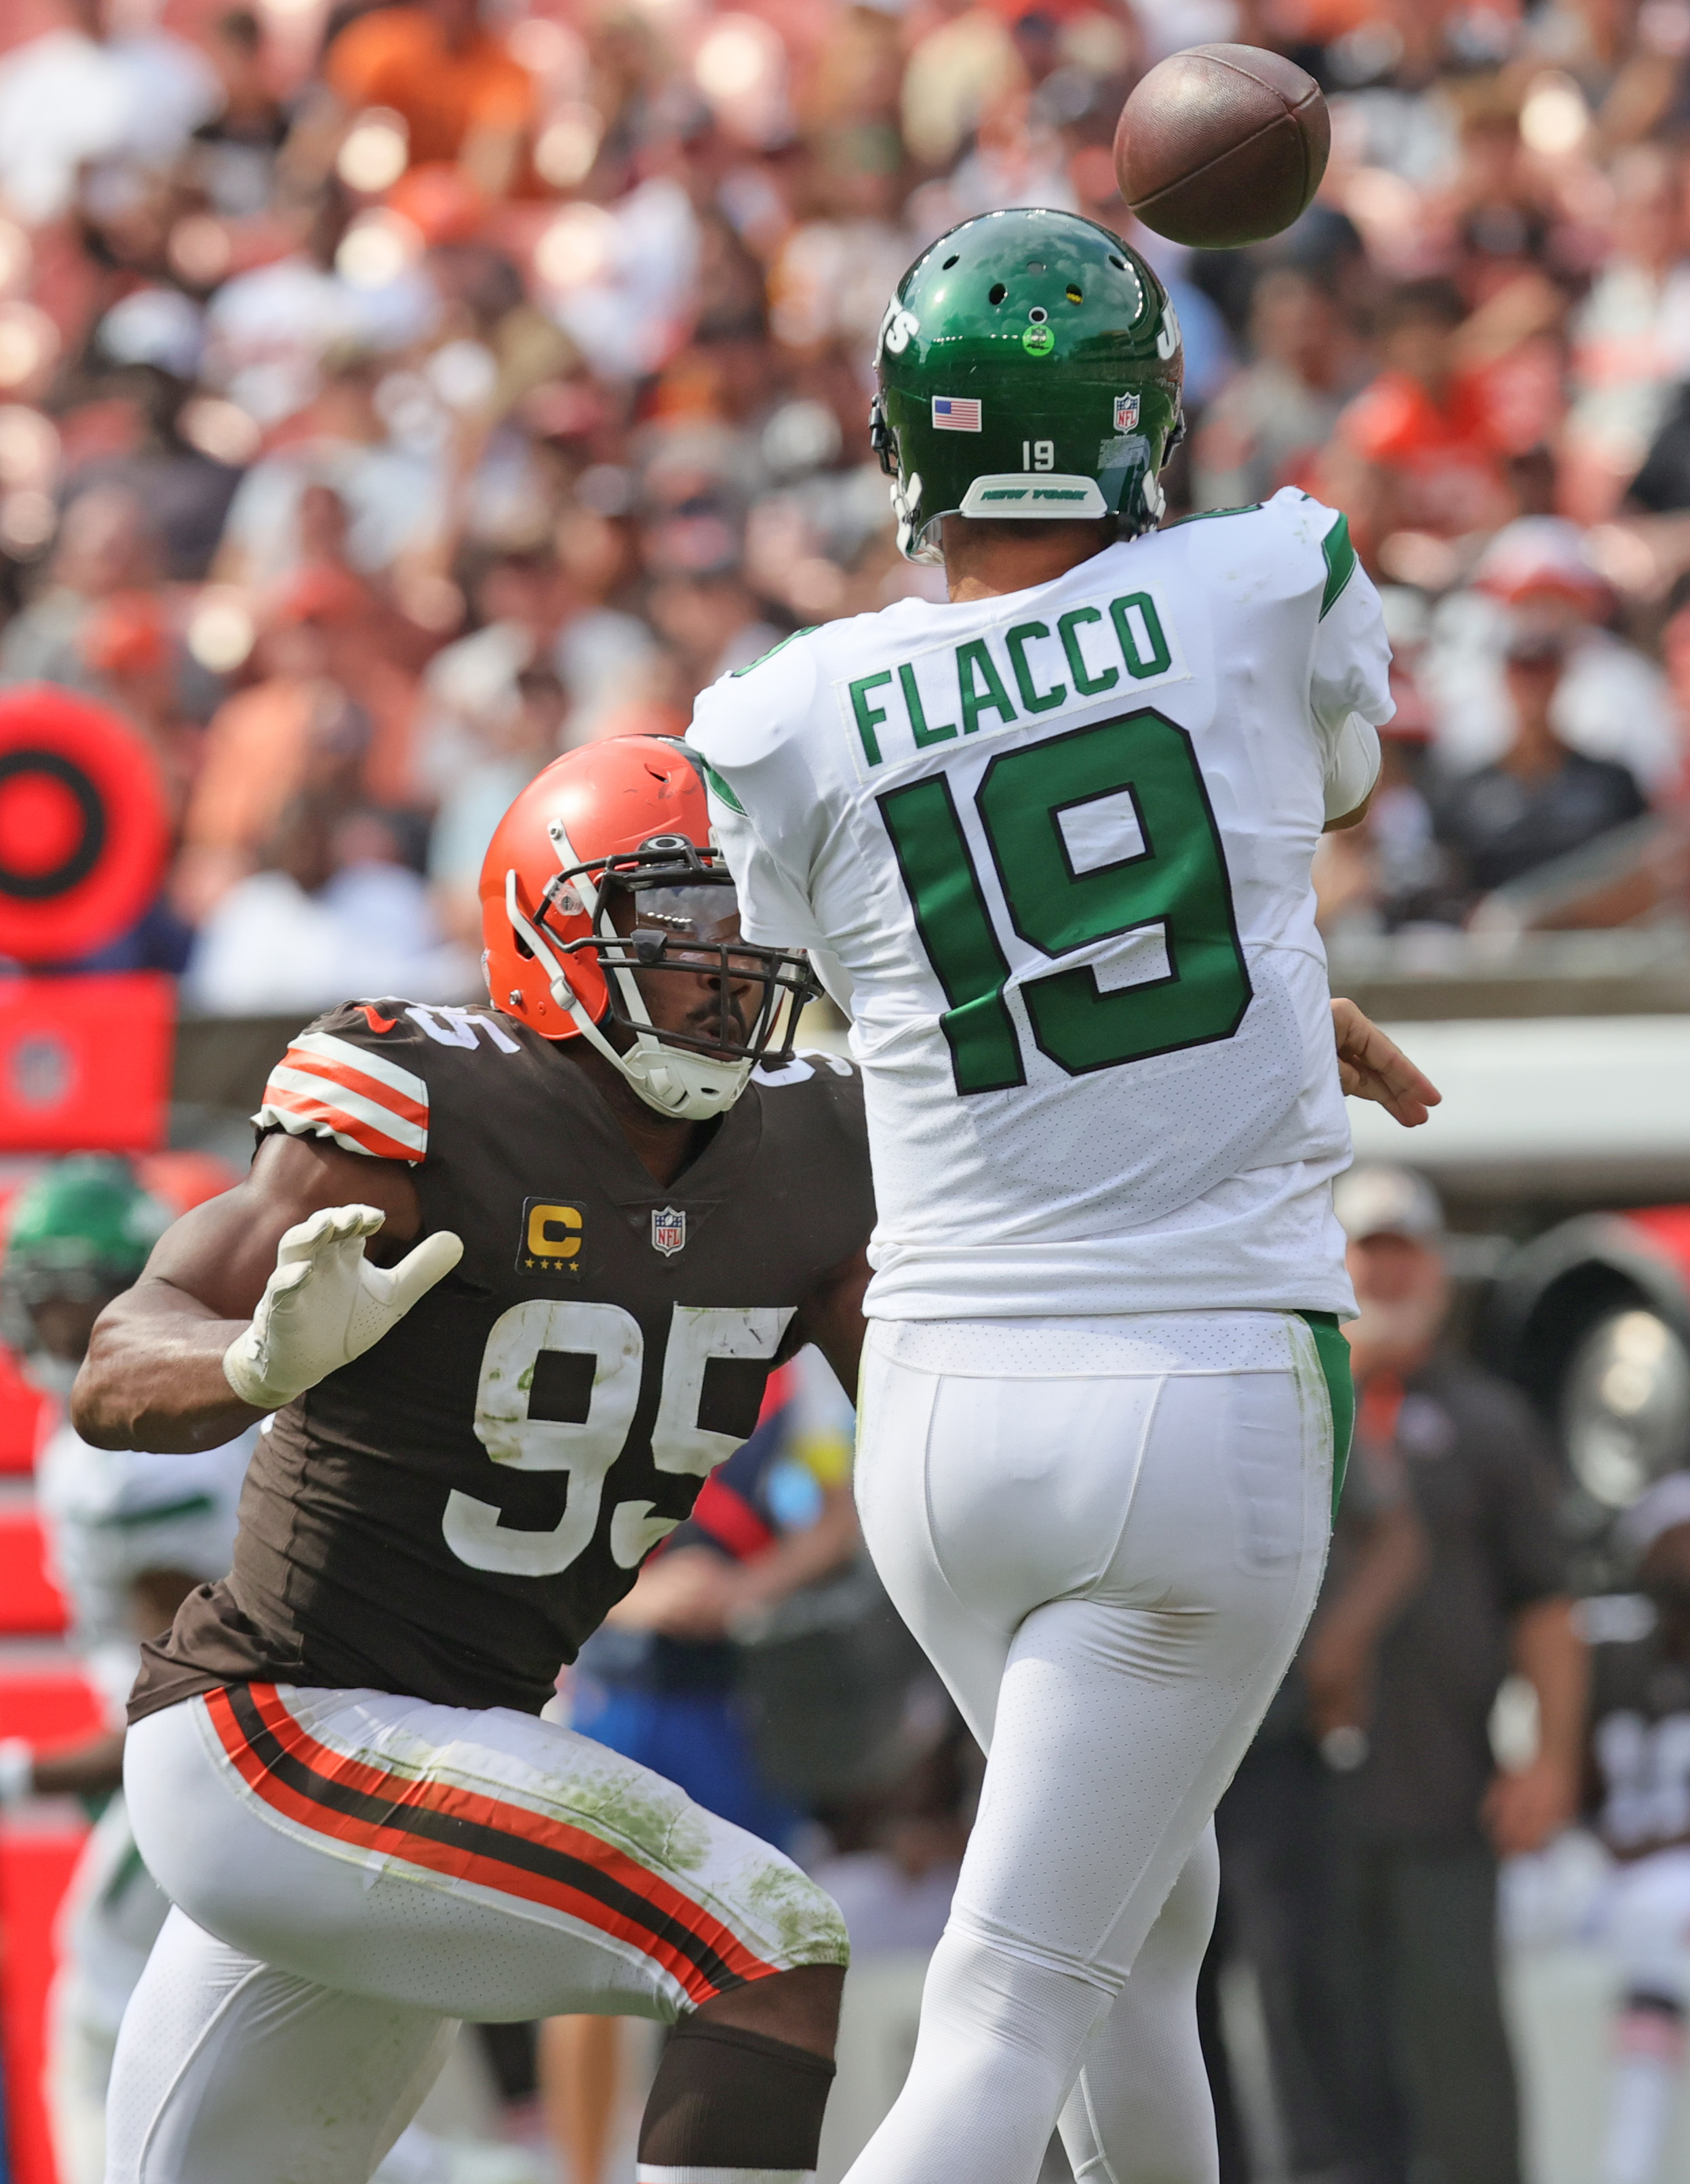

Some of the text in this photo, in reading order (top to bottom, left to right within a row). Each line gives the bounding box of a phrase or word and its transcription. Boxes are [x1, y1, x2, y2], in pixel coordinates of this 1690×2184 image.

[1117, 410, 1136, 427] NFL
[1022, 440, 1055, 471] 19
[981, 489, 1088, 501] NEW YORK
[848, 591, 1172, 767] FLACCO
[874, 706, 1254, 1096] 19
[528, 1204, 582, 1258] C
[658, 1228, 680, 1247] NFL
[442, 1298, 799, 1578] 95
